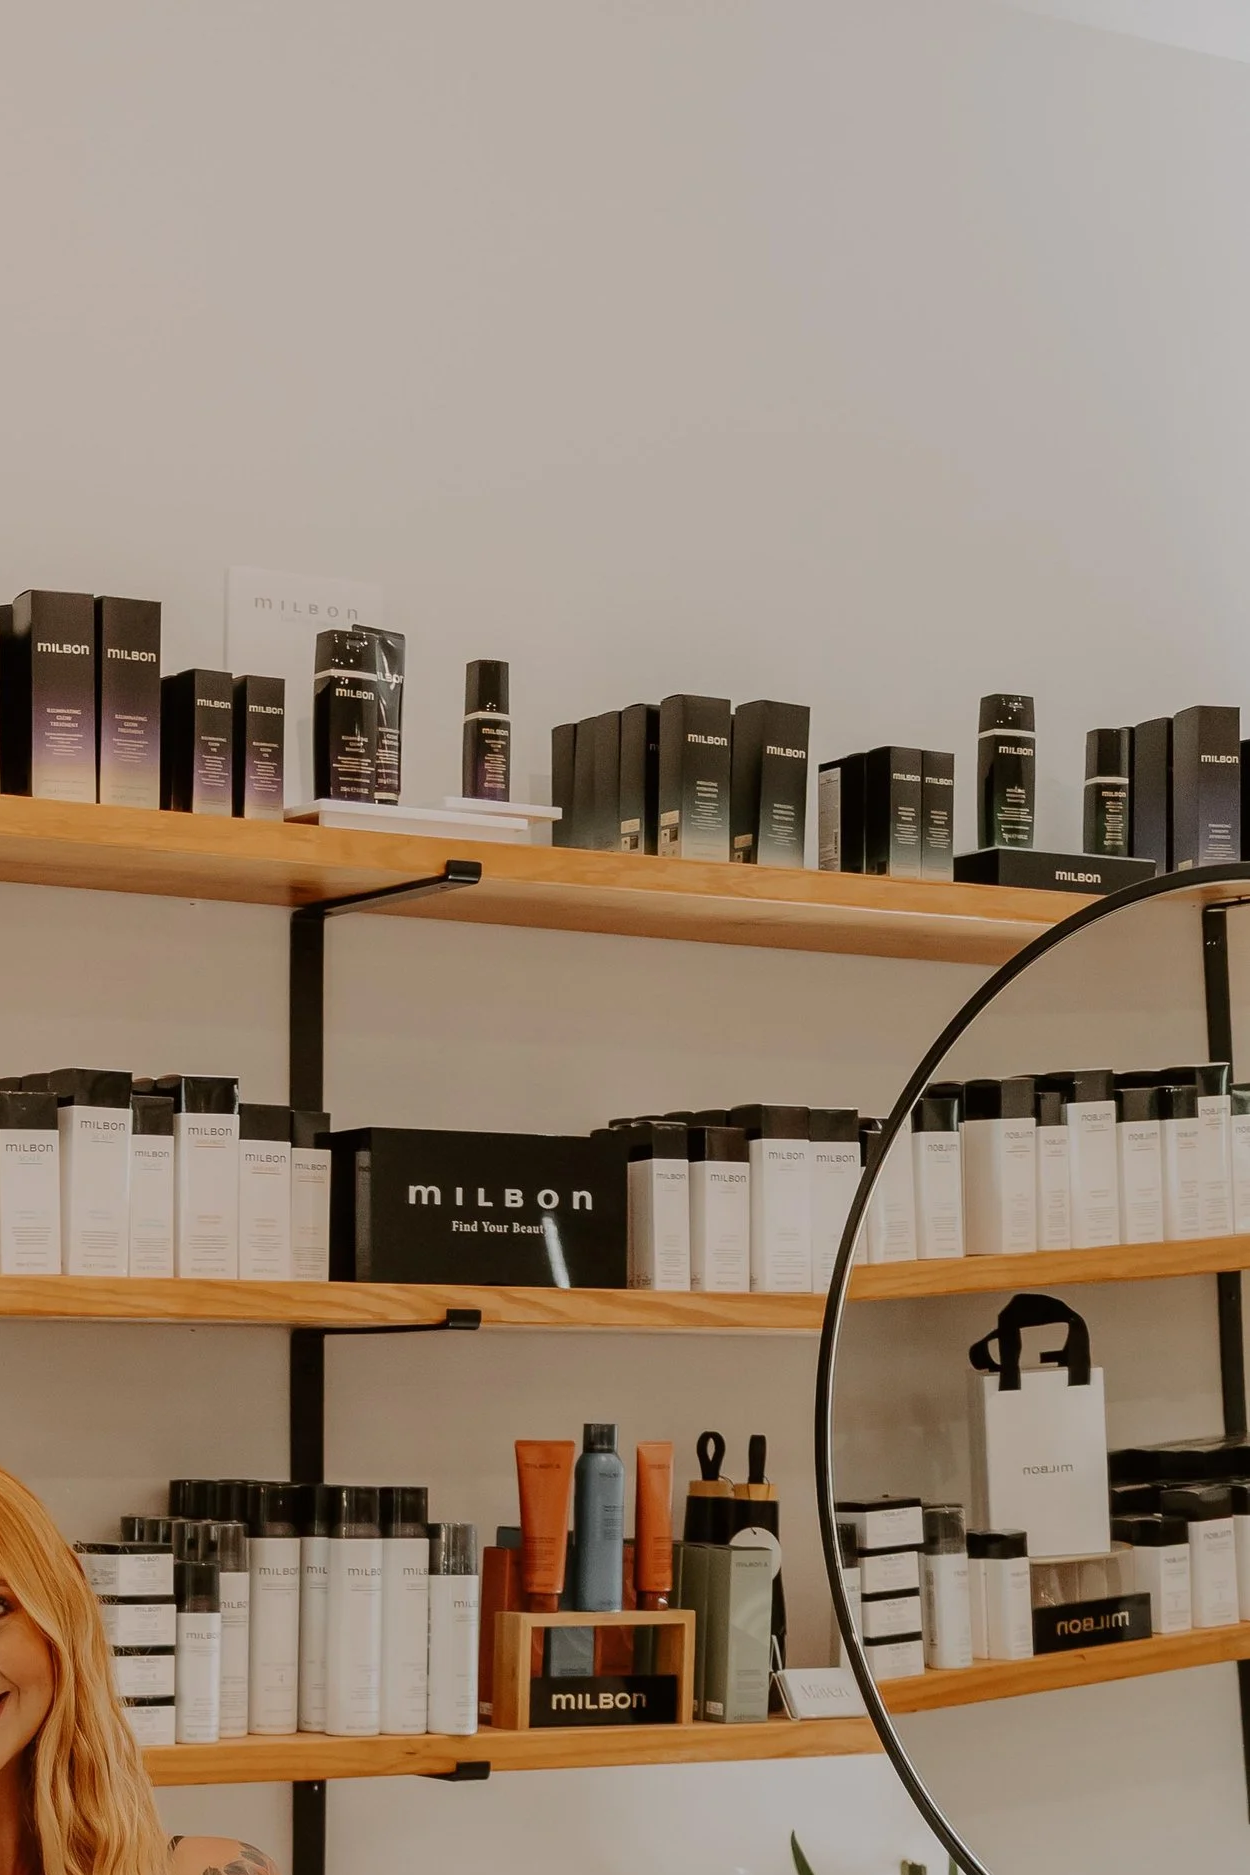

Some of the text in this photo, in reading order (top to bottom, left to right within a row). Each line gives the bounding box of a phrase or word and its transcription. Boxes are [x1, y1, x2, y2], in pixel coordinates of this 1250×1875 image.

[408, 1184, 593, 1211] MILBON
[451, 1220, 547, 1235] Find Your Beaut
